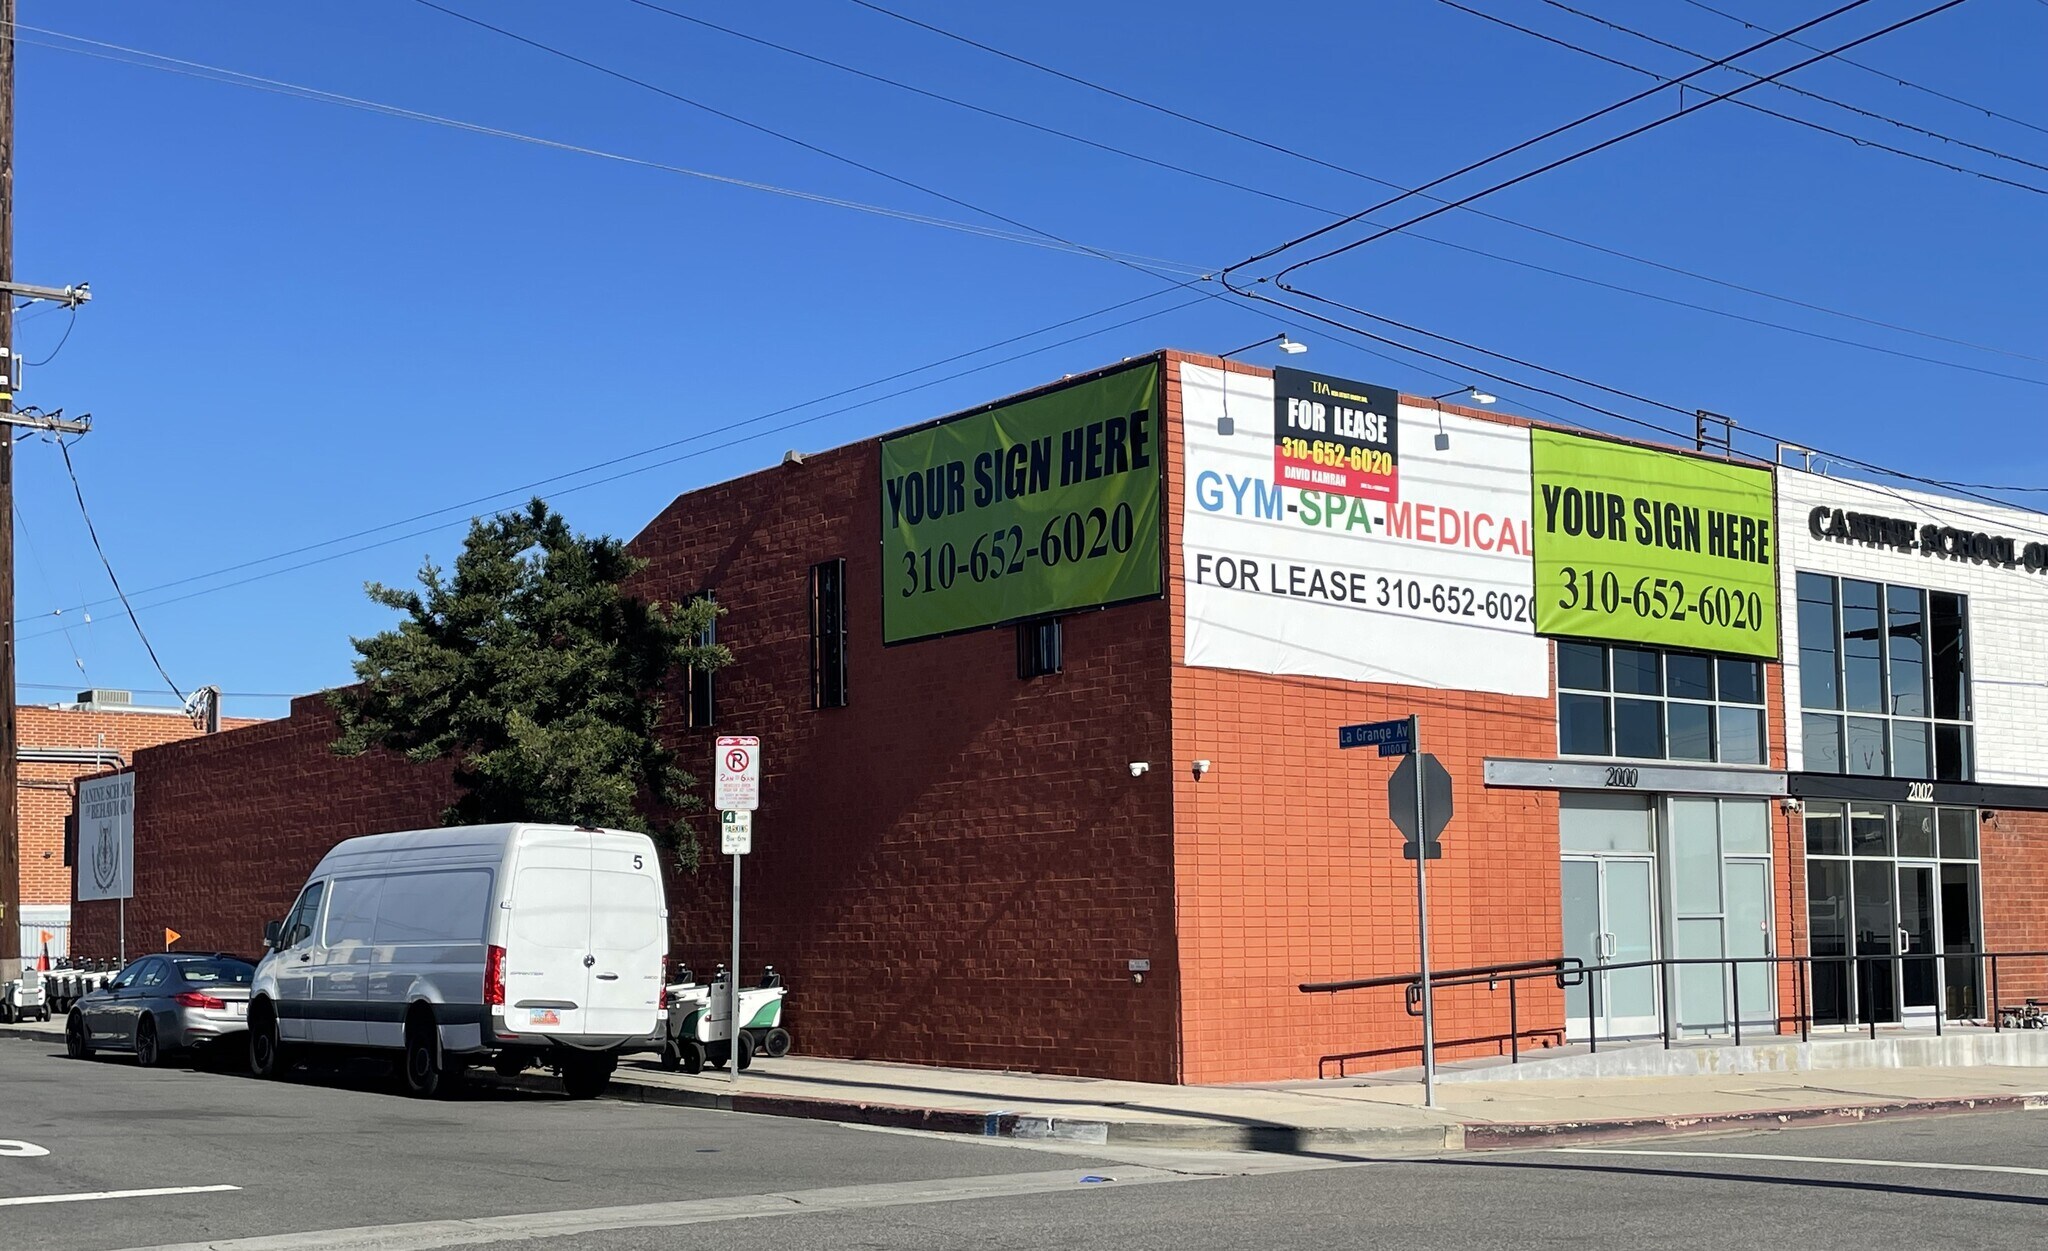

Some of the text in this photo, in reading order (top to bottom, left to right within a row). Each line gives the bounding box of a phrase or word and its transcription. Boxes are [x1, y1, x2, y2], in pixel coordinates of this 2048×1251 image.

[1288, 397, 1388, 445] FOR LEASE
[886, 409, 1150, 529] YOUR SIGN HERE
[1282, 436, 1393, 477] 310-652-6020
[1284, 465, 1311, 482] DAVID
[1311, 470, 1347, 488] KAMRAN
[1196, 470, 1532, 556] GYM-SPA-MEDICAL
[1541, 484, 1769, 565] YOUR SIGN HERE
[902, 502, 1134, 598] 310-652-6020
[1808, 506, 1918, 552] CANINE
[1920, 524, 2016, 570] SCHOOL
[1197, 554, 1260, 592] FOR
[1271, 563, 1367, 604] LEASE
[1558, 566, 1763, 632] 310-652-6020
[1341, 723, 1408, 743] La Grange Av
[81, 781, 133, 804] CANINE SCHOOL
[1605, 766, 1638, 787] 2000
[1907, 781, 1934, 802] 2002
[725, 811, 733, 822] 4
[633, 854, 643, 870] 5
